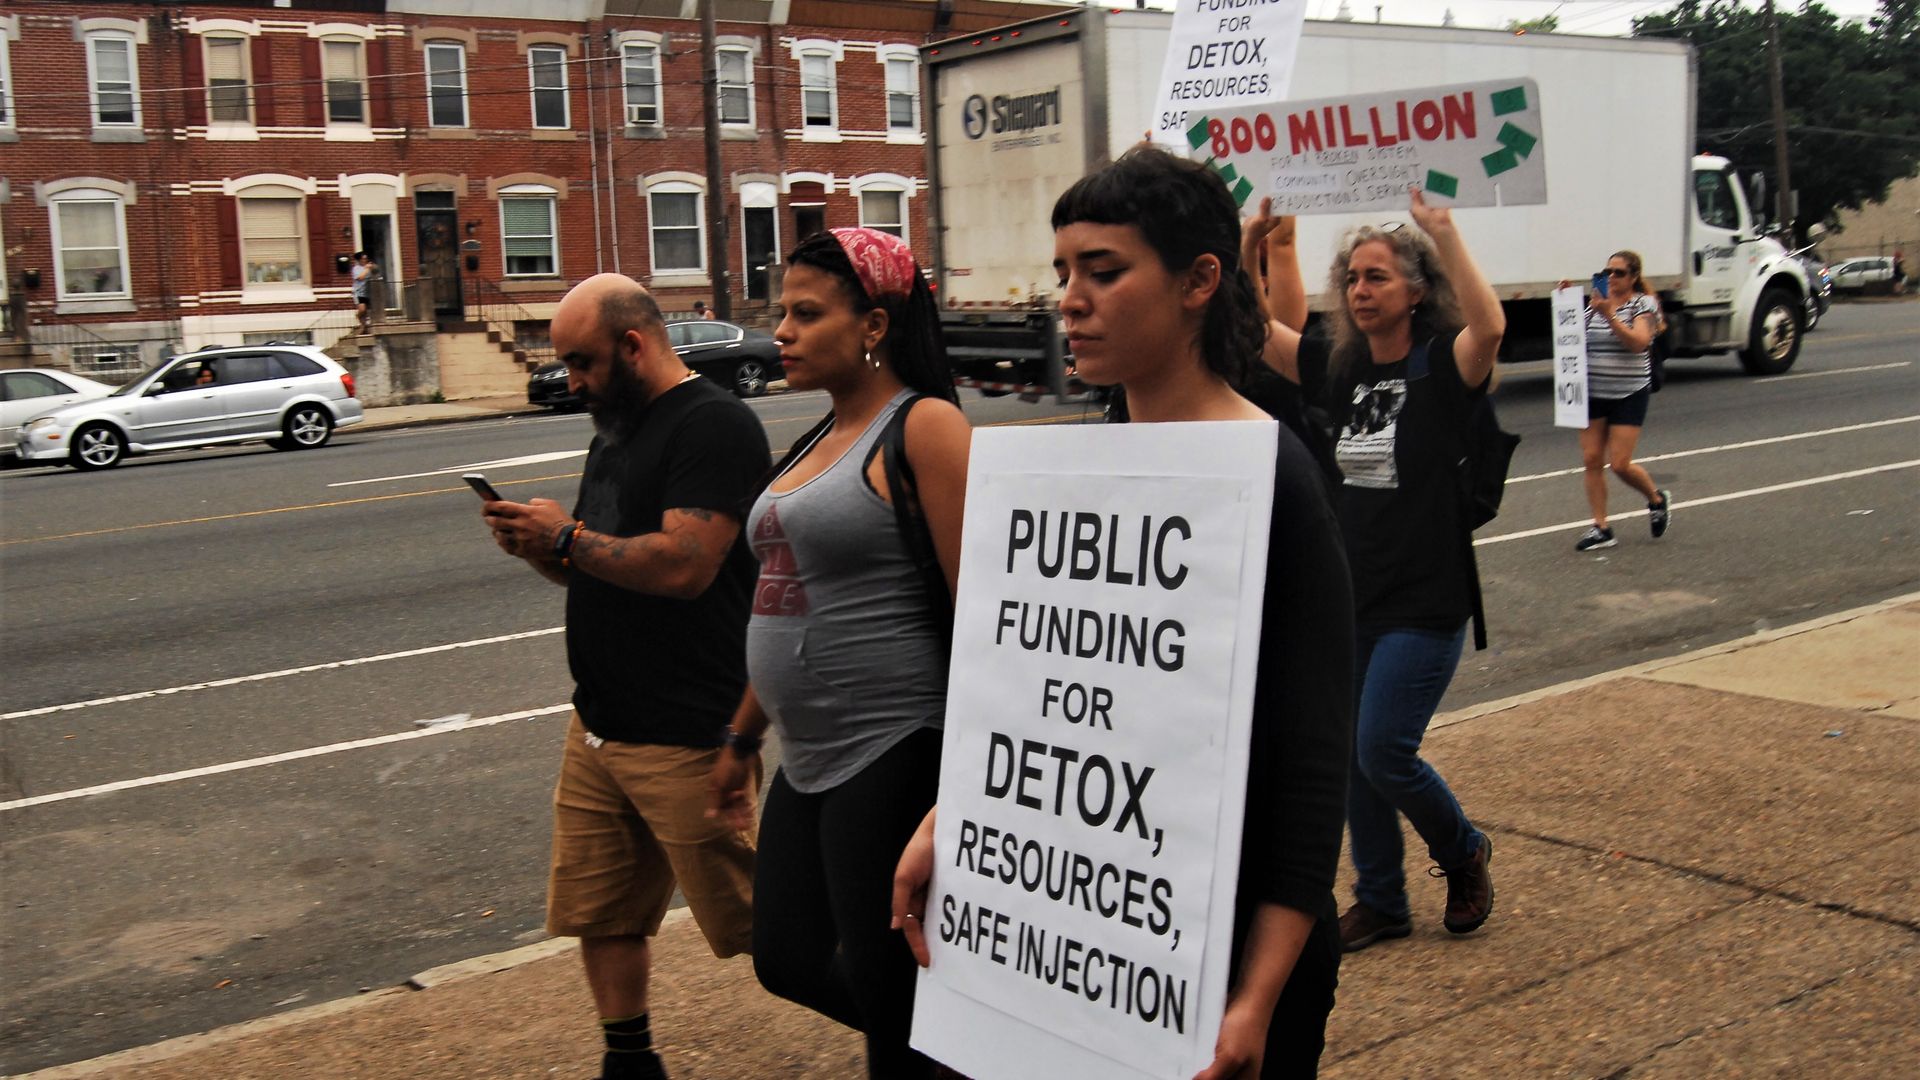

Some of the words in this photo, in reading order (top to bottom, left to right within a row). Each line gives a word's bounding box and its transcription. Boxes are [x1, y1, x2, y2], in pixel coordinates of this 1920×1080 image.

[1218, 16, 1251, 33] FOR
[1187, 37, 1267, 70] DETOX,
[1170, 74, 1272, 100] RESOURCES,
[1160, 110, 1188, 131] SAF
[1208, 112, 1276, 158] 800
[1288, 91, 1477, 155] MILLION
[1275, 173, 1337, 190] COMMUNITY
[1345, 163, 1421, 187] OVERSIGHT
[1315, 150, 1358, 166] BROKEN
[1368, 145, 1418, 161] SYSTEM
[1006, 509, 1193, 590] PUBLIC
[996, 600, 1185, 672] FUNDING
[1042, 678, 1113, 731] FOR
[984, 732, 1164, 858] DETOX,
[956, 820, 1182, 952] RESOURCES,
[940, 893, 1010, 965] SAFE
[1016, 921, 1187, 1035] INJECTION
